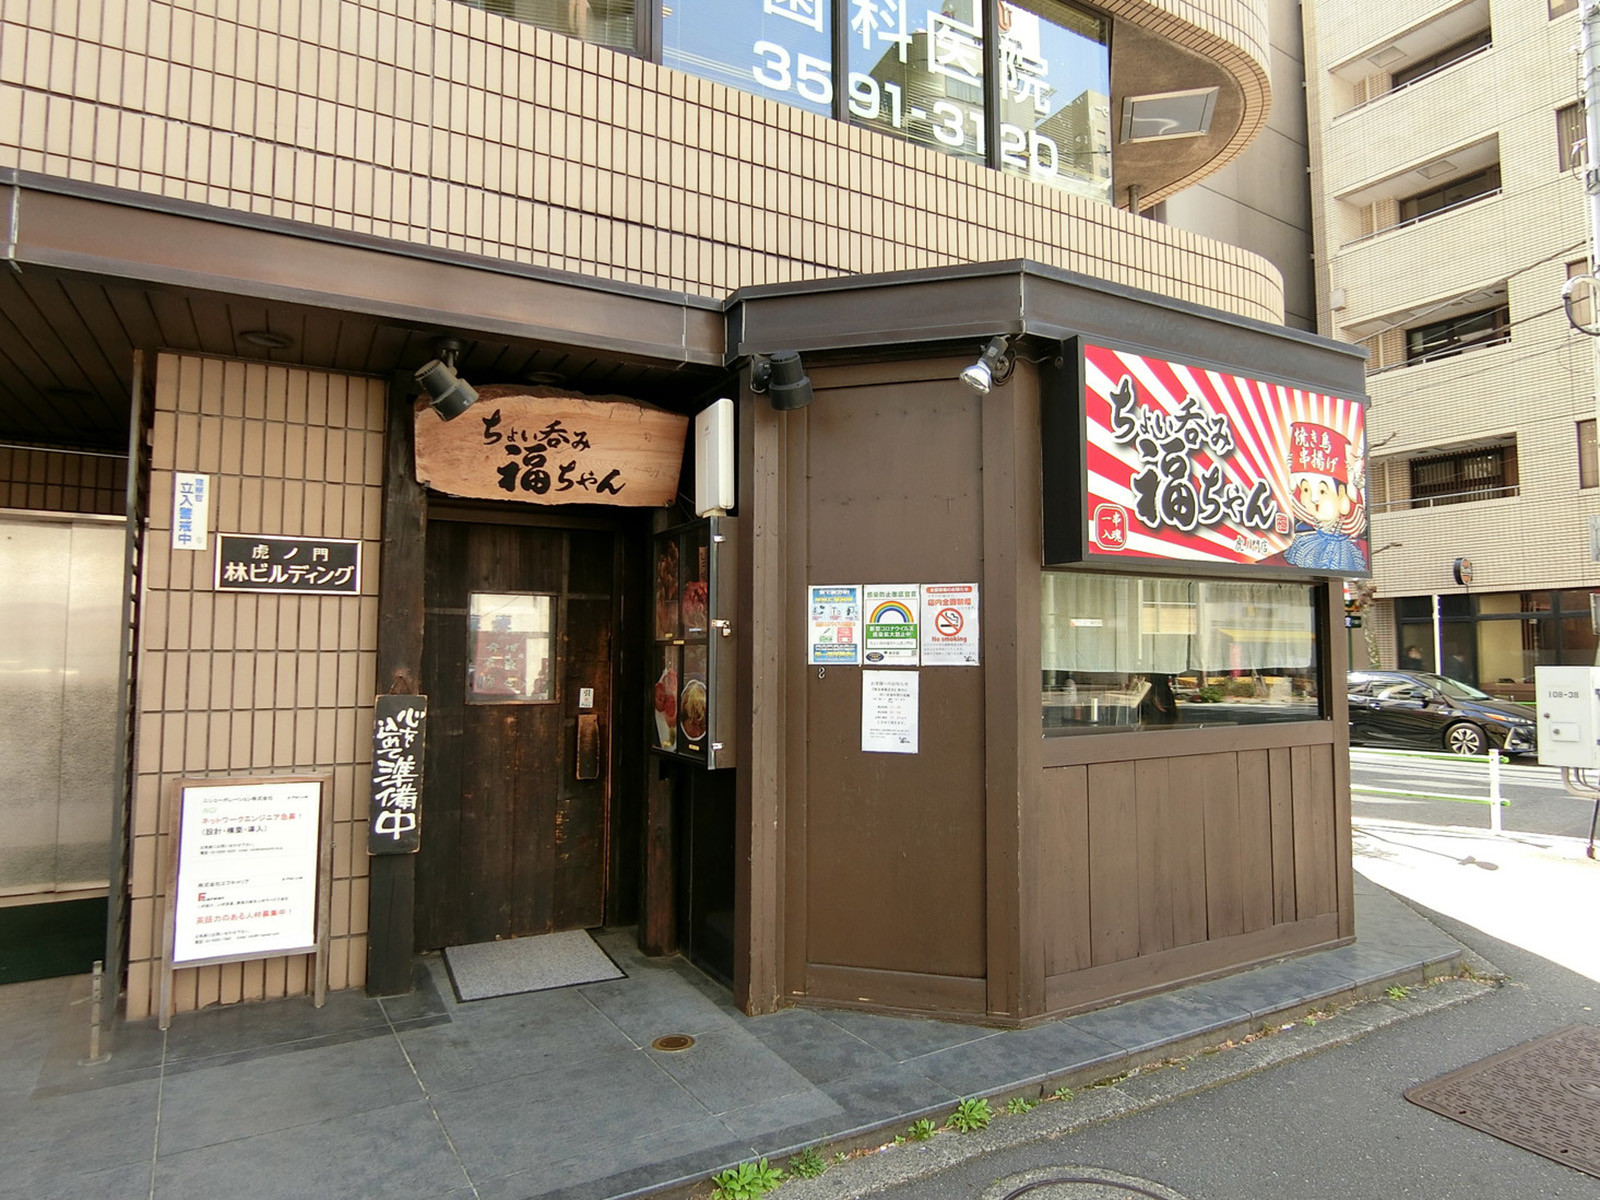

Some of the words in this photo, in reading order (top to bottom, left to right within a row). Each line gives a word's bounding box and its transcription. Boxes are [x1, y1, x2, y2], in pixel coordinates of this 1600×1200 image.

[1110, 378, 1232, 452] ちょい呑み
[483, 409, 590, 451] ちょい呑み
[1294, 427, 1331, 454] 焼き鳥
[497, 444, 626, 495] 福ちゃん
[1299, 446, 1338, 473] 串揚げ
[1134, 438, 1275, 528] 福ちゃん
[1101, 511, 1121, 527] 一串
[252, 544, 329, 562] 虎ノ門
[223, 562, 355, 586] 林ビルディング
[1549, 691, 1579, 699] 108-38
